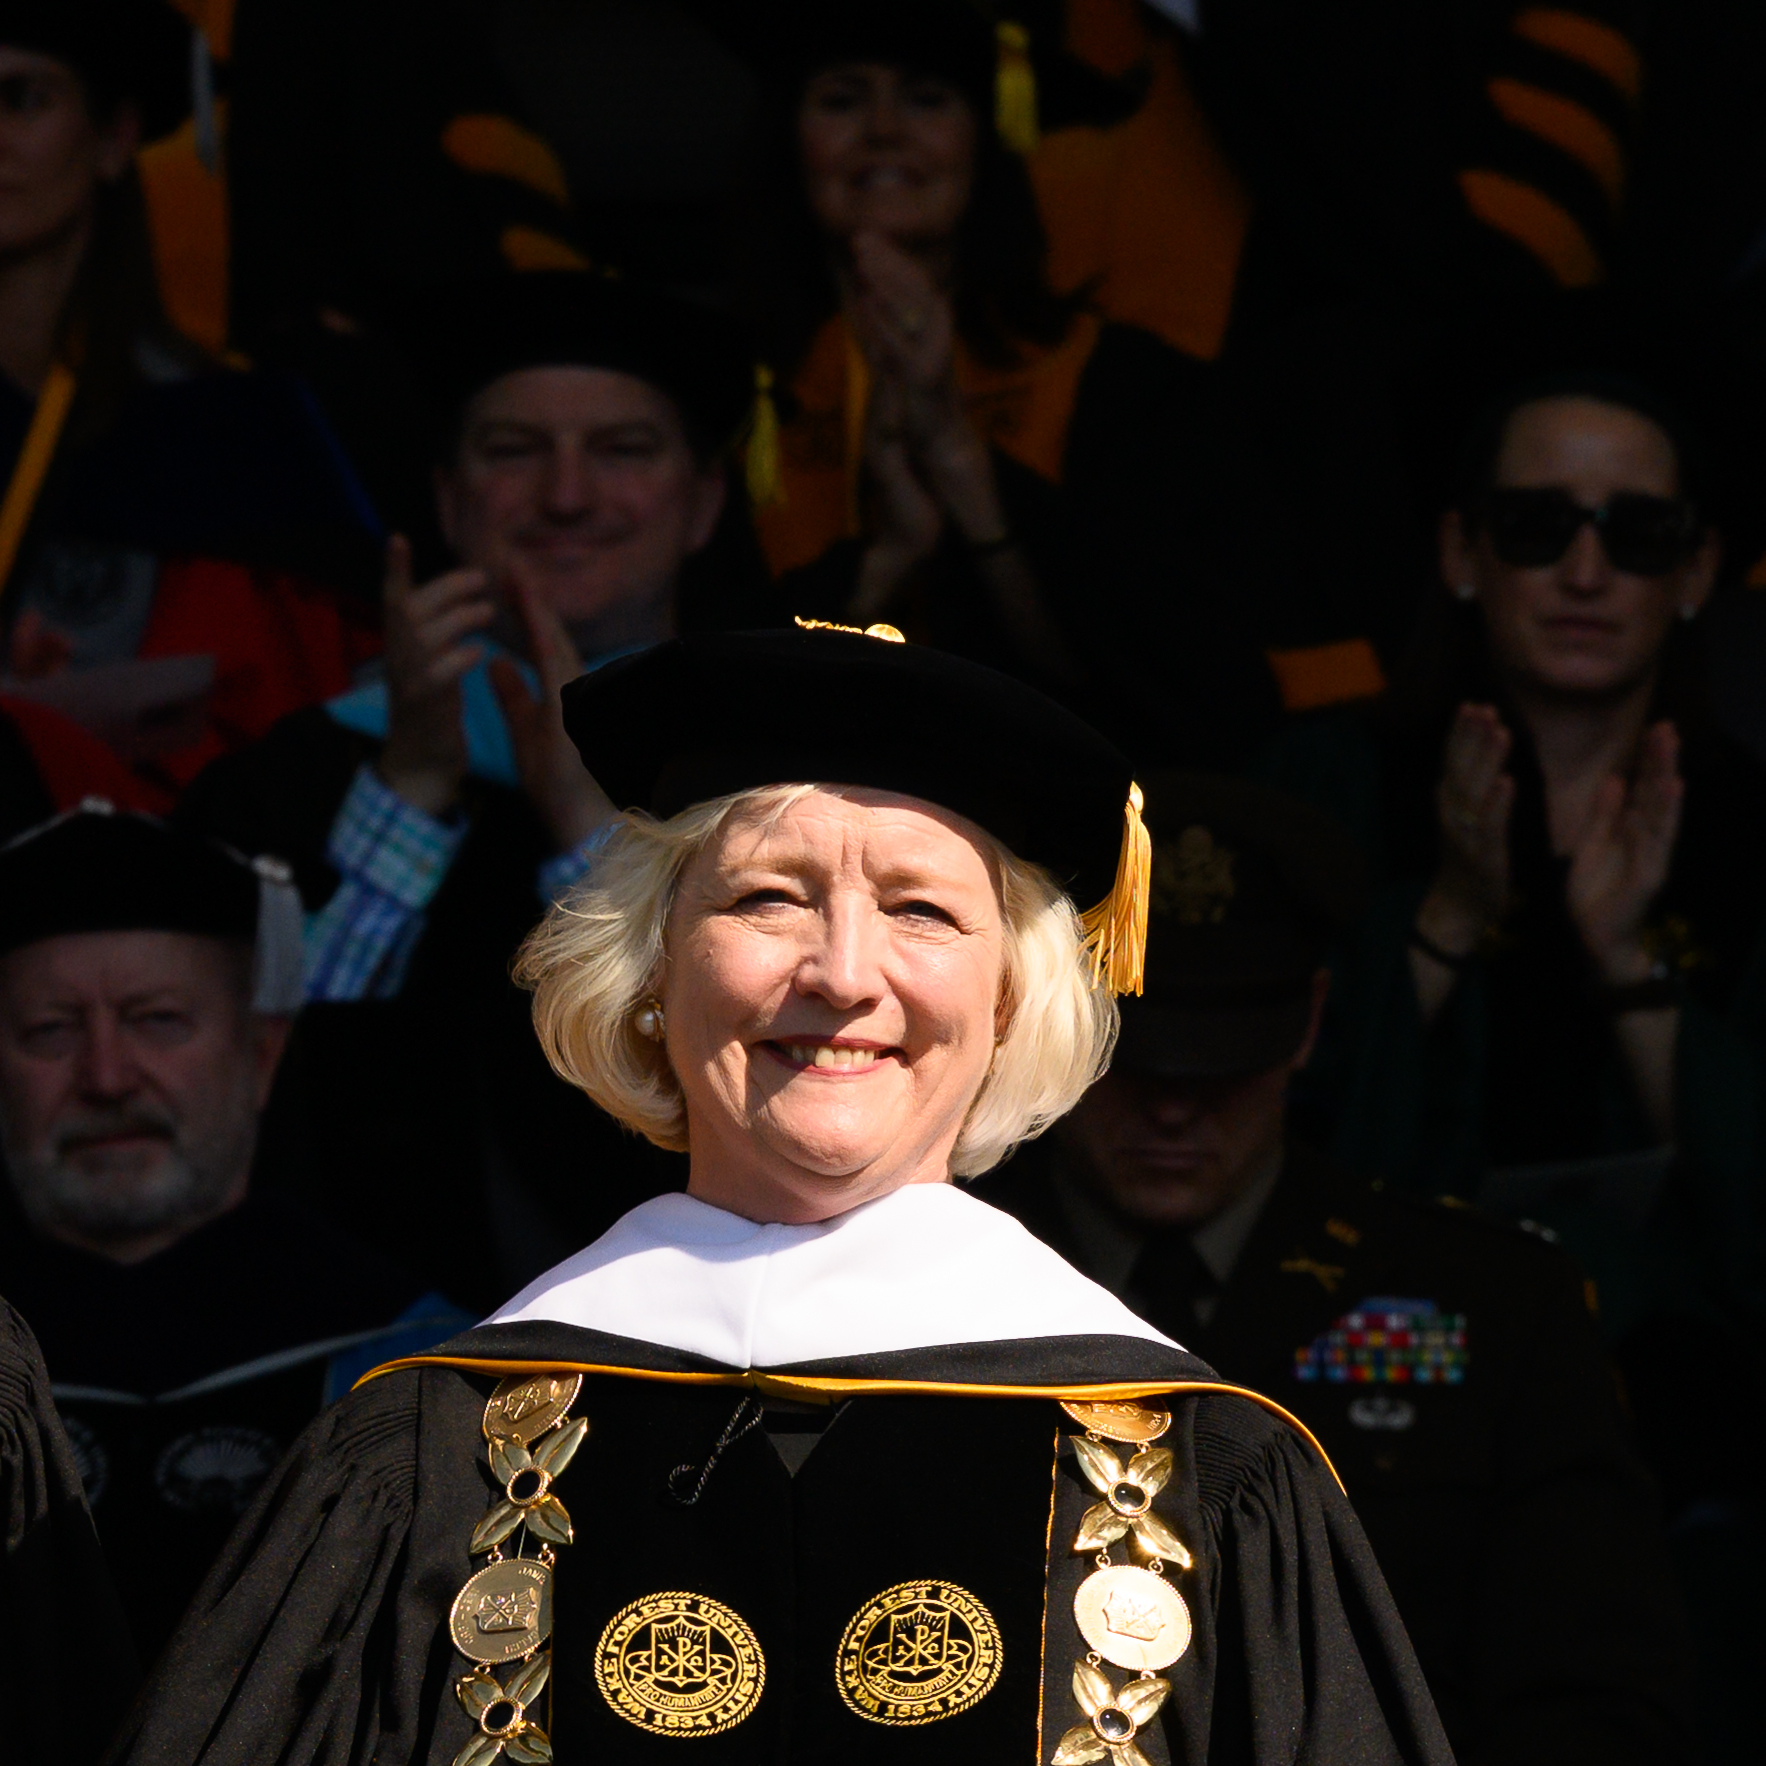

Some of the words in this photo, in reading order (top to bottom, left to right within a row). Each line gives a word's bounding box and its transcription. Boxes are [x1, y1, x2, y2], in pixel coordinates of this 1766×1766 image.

[606, 1599, 691, 1654] FOREST
[847, 1586, 932, 1650] FOREST
[939, 1588, 994, 1708] UNIVERSITY
[603, 1657, 646, 1719] WAKE
[698, 1603, 757, 1723] UNIVERSITY
[844, 1655, 880, 1713] WAKE
[652, 1713, 712, 1728] 1834
[884, 1700, 943, 1718] 1834
